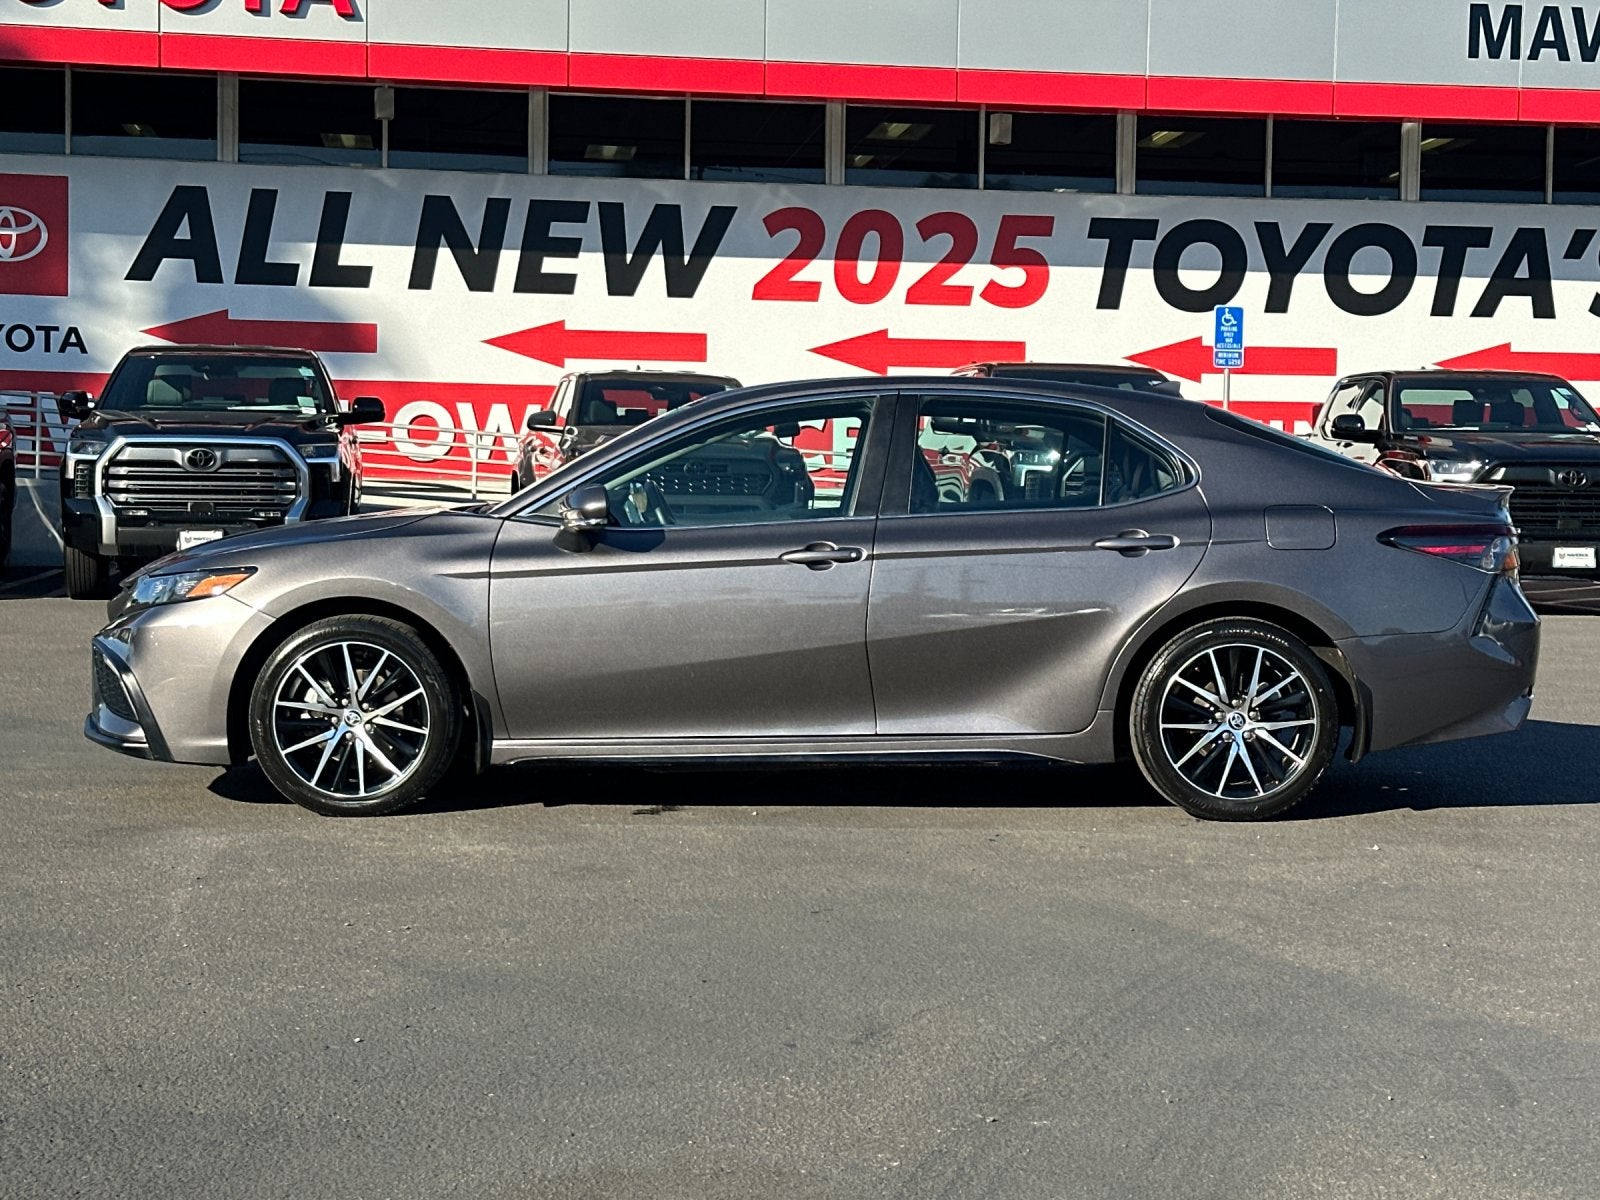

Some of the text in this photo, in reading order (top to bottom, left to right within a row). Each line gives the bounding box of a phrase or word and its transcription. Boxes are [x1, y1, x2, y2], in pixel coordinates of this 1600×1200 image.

[1468, 3, 1600, 63] MAV
[124, 185, 1600, 319] ALL NEW 2025 TOYOTA'
[0, 323, 88, 354] OTA
